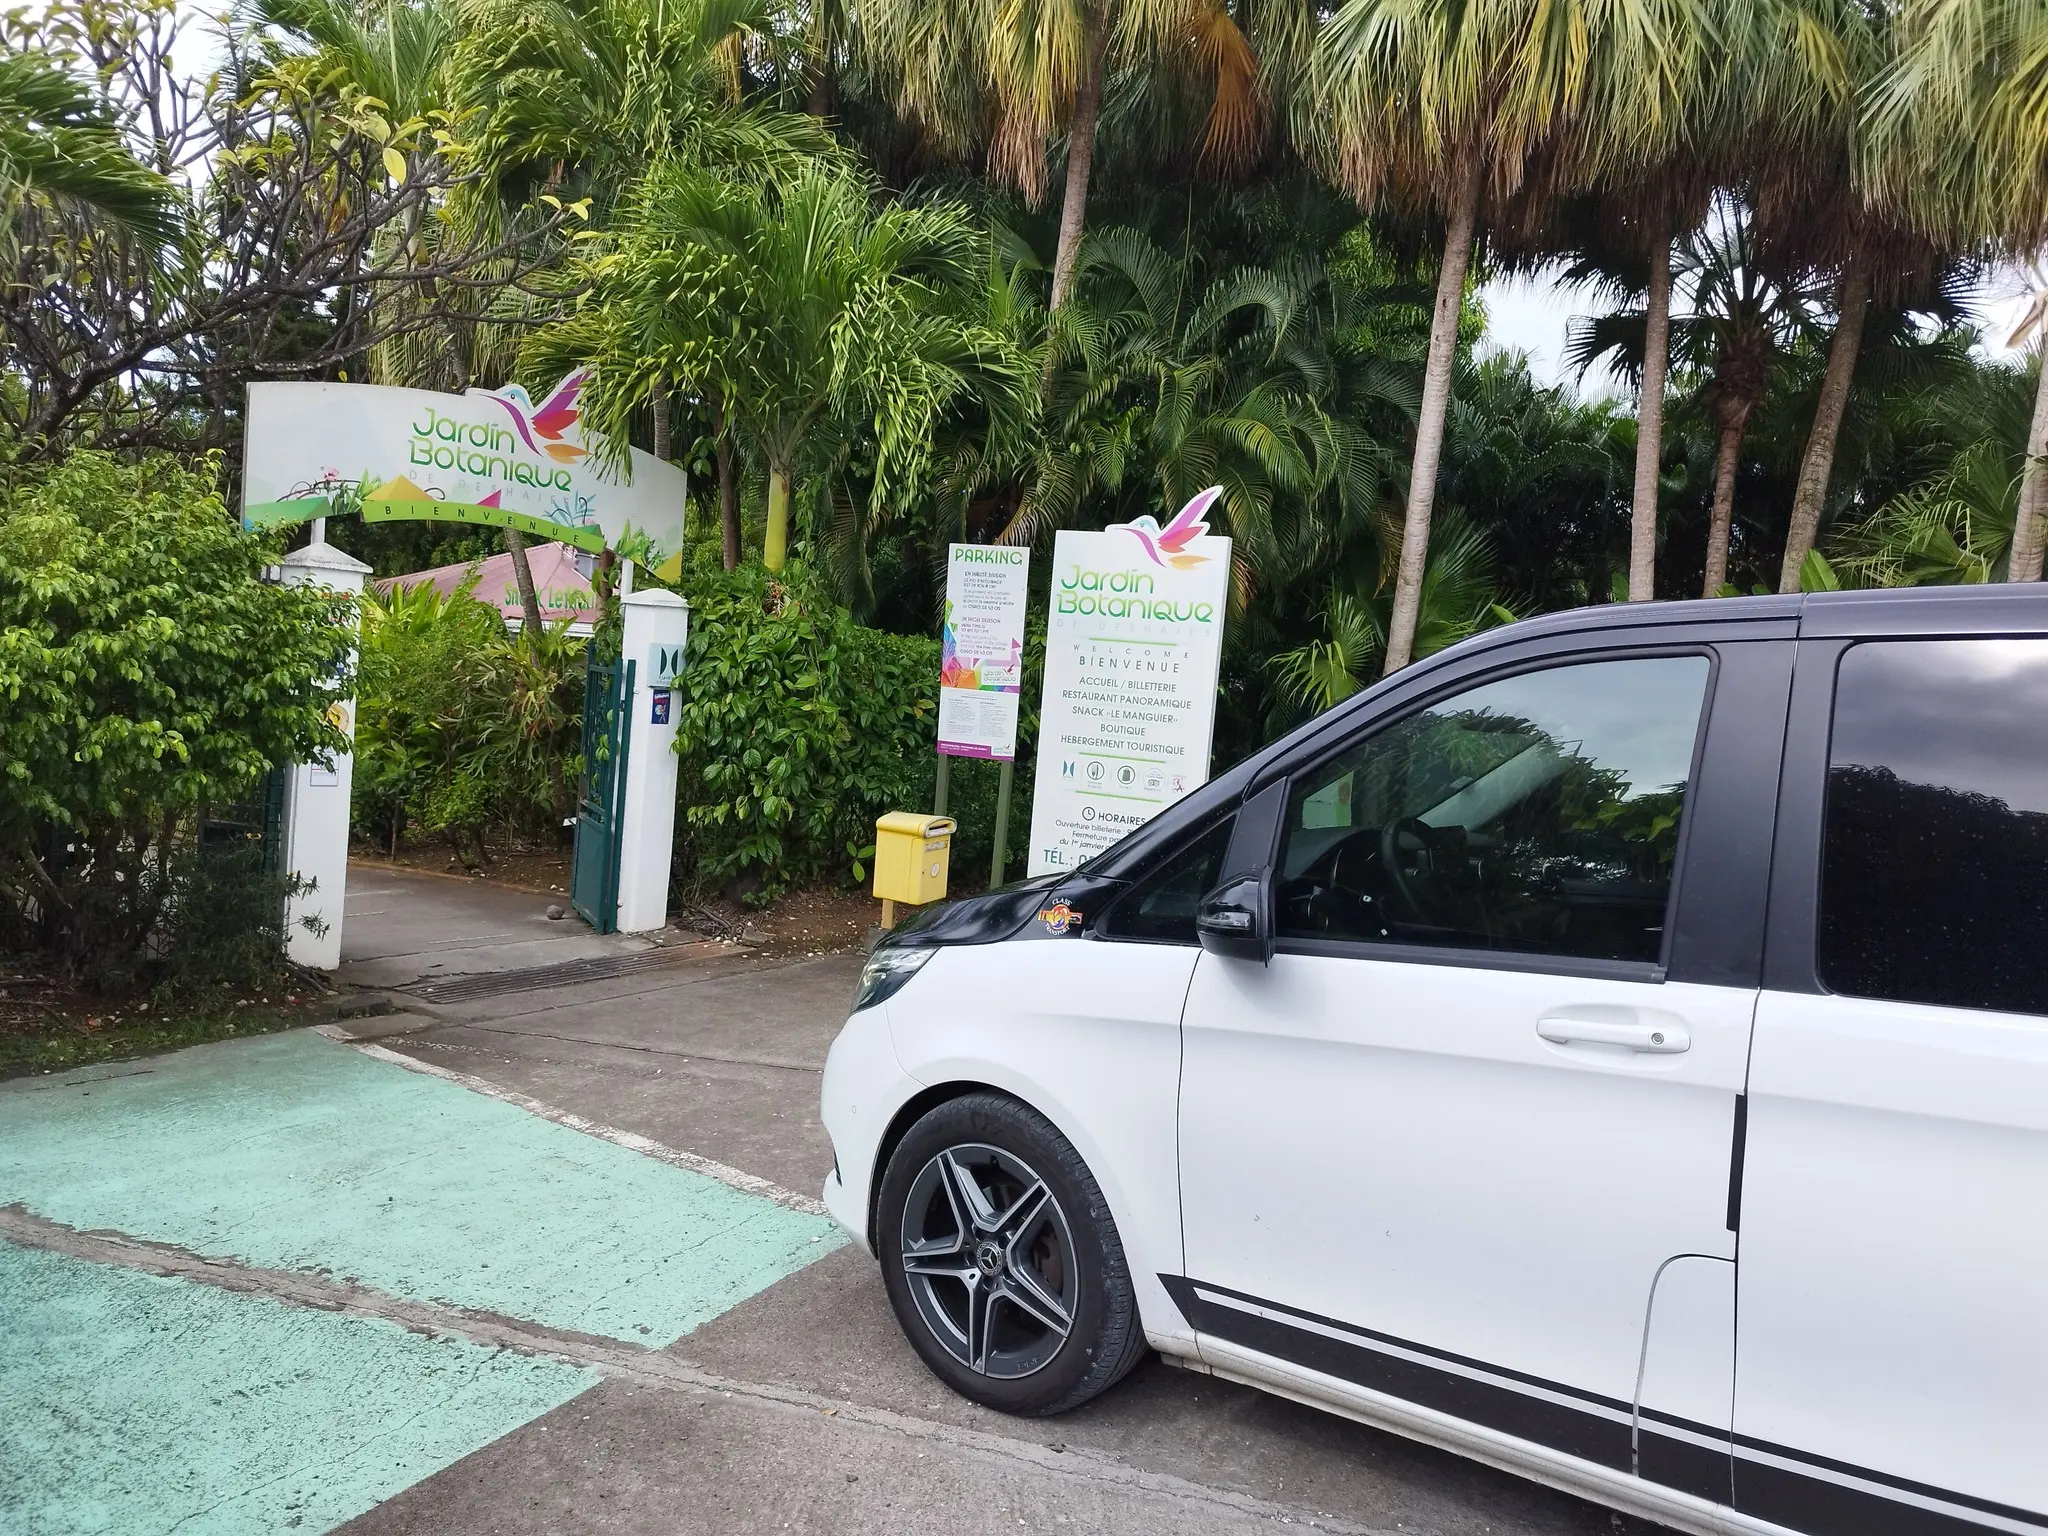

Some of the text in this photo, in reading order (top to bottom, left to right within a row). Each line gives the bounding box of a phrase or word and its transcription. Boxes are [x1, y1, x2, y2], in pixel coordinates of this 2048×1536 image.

[412, 408, 516, 454] Jardin
[409, 436, 572, 492] Botanique
[385, 505, 580, 544] BIENVENUE
[955, 548, 1023, 566] PARKING
[1060, 564, 1155, 594] Jardin
[1057, 590, 1214, 623] Botanique
[1073, 644, 1189, 659] WELCOME
[1079, 656, 1180, 673] BIENVENUE
[1079, 676, 1118, 688] ACCUEIL
[1128, 680, 1177, 693] BILLETTERIE
[1062, 690, 1192, 710] RESTAURANT PANORAMIQUE
[1072, 706, 1104, 718] SNACK
[1100, 724, 1146, 736] BOUTIQUE
[1060, 735, 1186, 756] HEBERGEMENT TOURISTIQUE
[1055, 819, 1090, 831] Ouverture
[1098, 812, 1146, 826] HORAIRES
[1059, 838, 1069, 846] du
[1079, 840, 1106, 850] janvier
[1072, 830, 1108, 842] Fermeture
[1044, 922, 1070, 936] TRANSPORT
